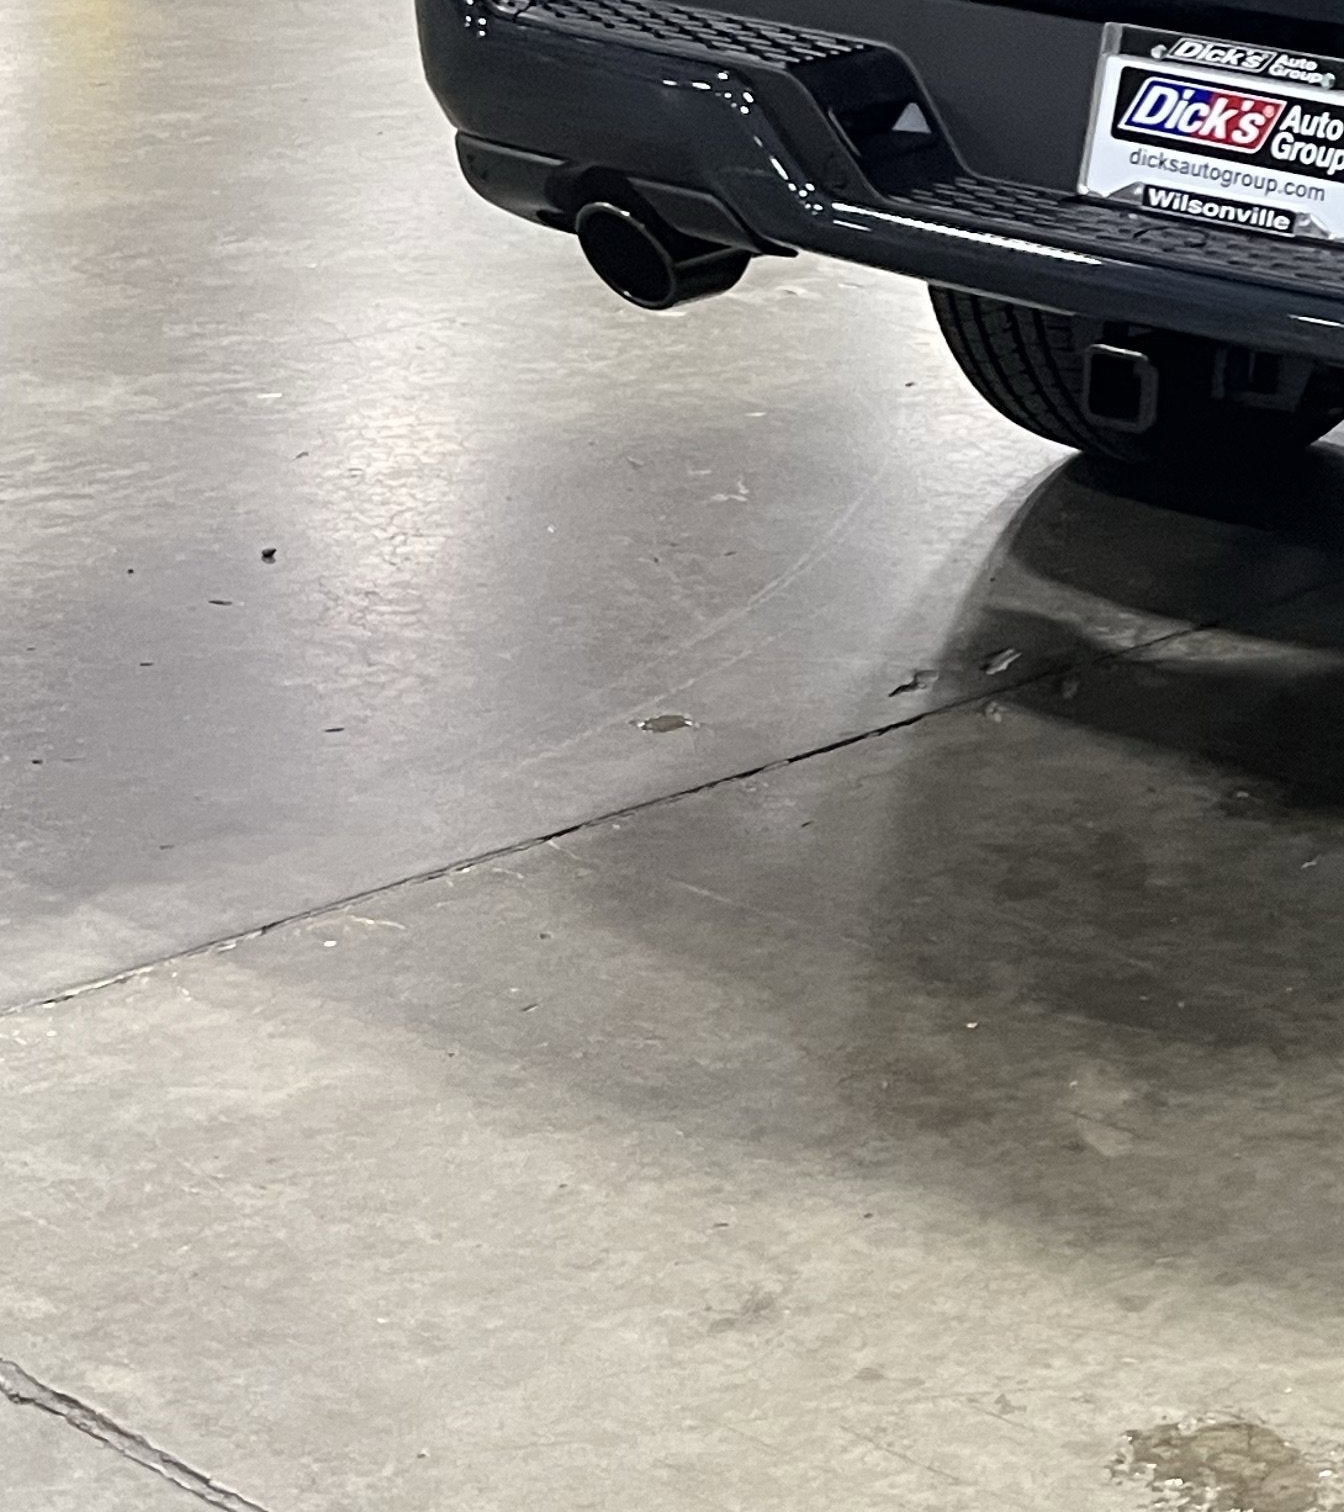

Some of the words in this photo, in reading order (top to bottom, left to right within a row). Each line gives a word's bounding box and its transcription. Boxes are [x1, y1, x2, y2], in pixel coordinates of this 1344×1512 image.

[1172, 39, 1267, 72] Dick's
[1273, 54, 1319, 72] Auto
[1269, 64, 1324, 85] Group
[1131, 84, 1267, 145] Dick's
[1279, 104, 1344, 141] Auto
[1129, 148, 1326, 202] dicksautogroup.com
[1147, 187, 1292, 231] Wilsonville
